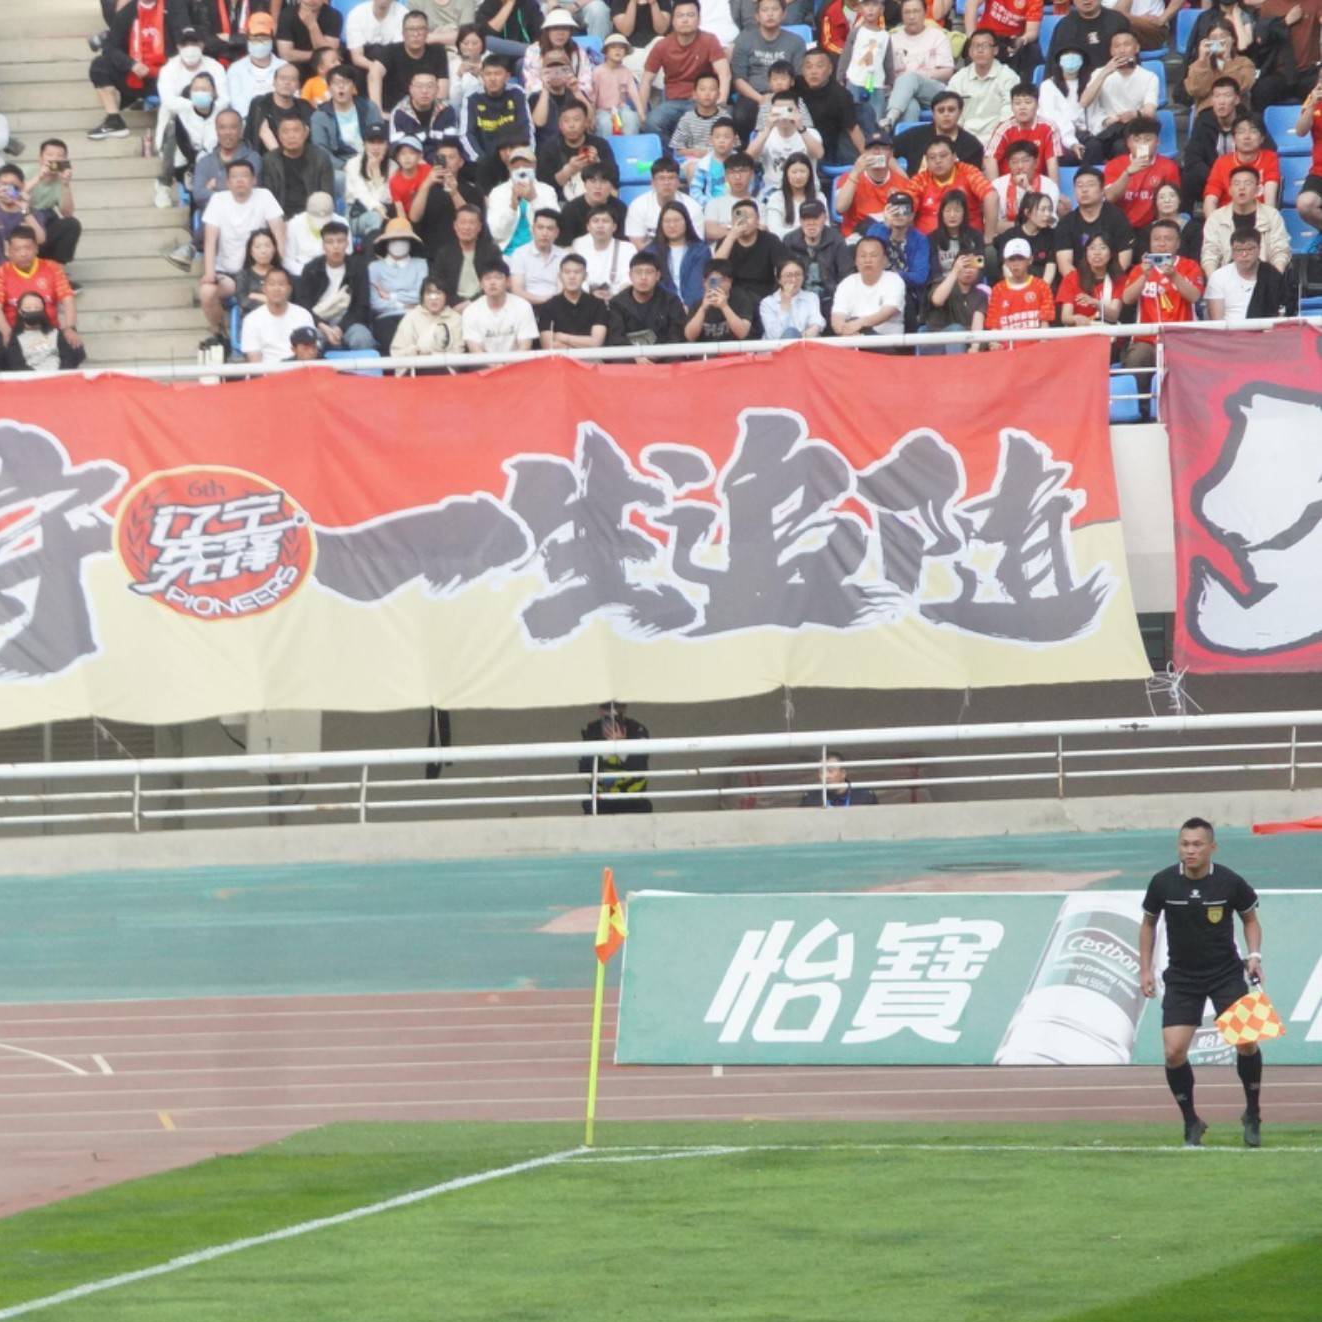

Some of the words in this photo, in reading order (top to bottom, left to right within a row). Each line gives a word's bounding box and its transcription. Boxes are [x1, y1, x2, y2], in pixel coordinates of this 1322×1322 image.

[187, 479, 227, 498] 6th
[150, 492, 302, 546] 辽宁
[311, 406, 1119, 650] 一生追随
[129, 531, 283, 594] 先锋
[165, 564, 299, 616] PIONEERS
[703, 916, 1006, 1046] 怡寶
[1067, 935, 1141, 975] Cestbon
